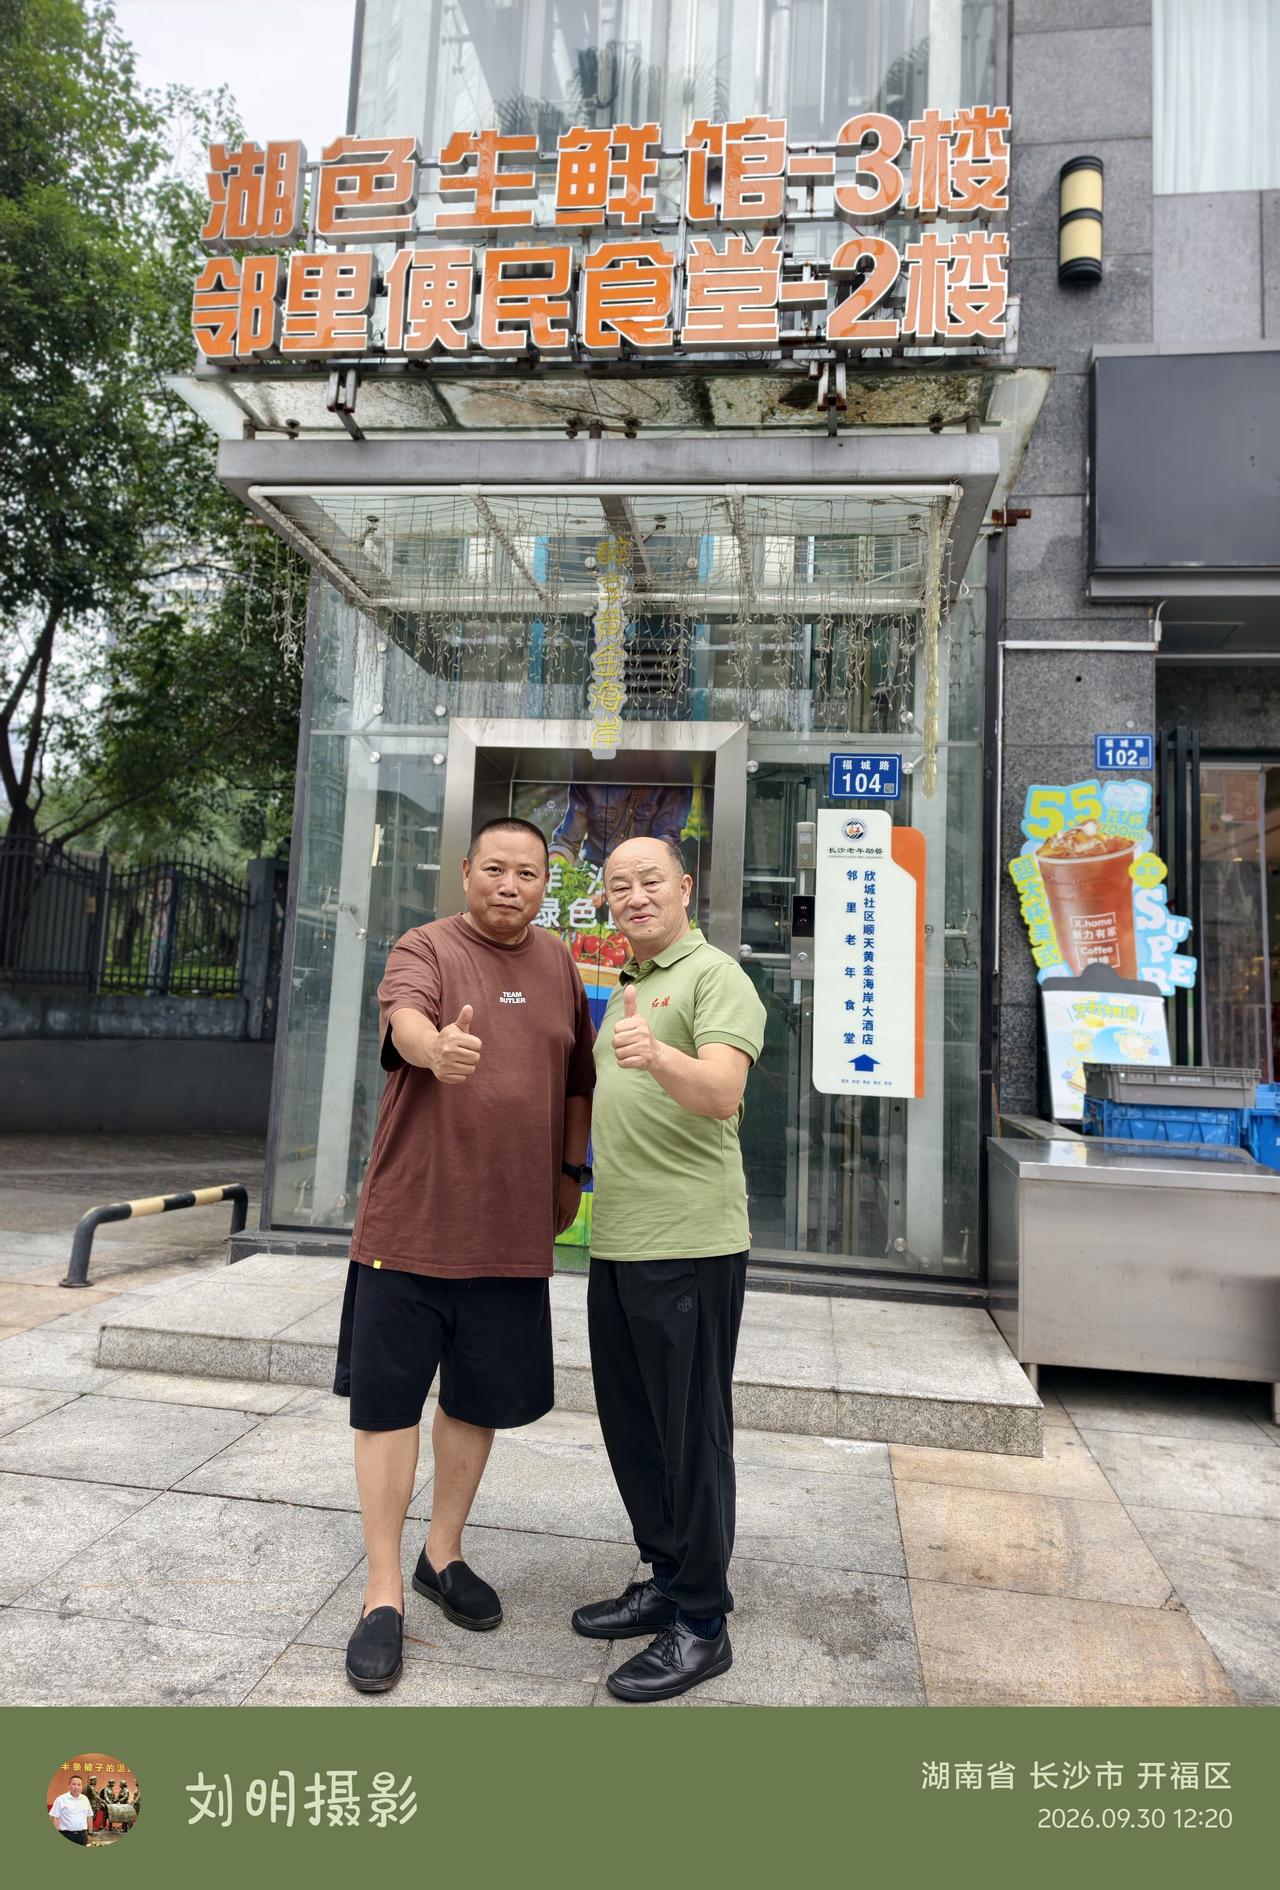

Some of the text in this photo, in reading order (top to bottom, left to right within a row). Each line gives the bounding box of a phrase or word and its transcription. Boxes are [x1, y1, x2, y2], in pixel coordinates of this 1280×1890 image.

[202, 105, 1011, 240] 湖色生鲜馆-3楼
[192, 231, 1010, 357] 邻里便民食堂-2楼
[842, 760, 890, 771] 福城路
[1105, 749, 1138, 765] 102
[842, 773, 881, 793] 104
[530, 897, 617, 929] 绿色
[843, 870, 858, 1045] 邻里老年食堂
[862, 870, 876, 1045] 欣城社区顺天黄金海岸大酒店
[1080, 946, 1113, 955] Coffee
[499, 996, 526, 1004] BUTLER
